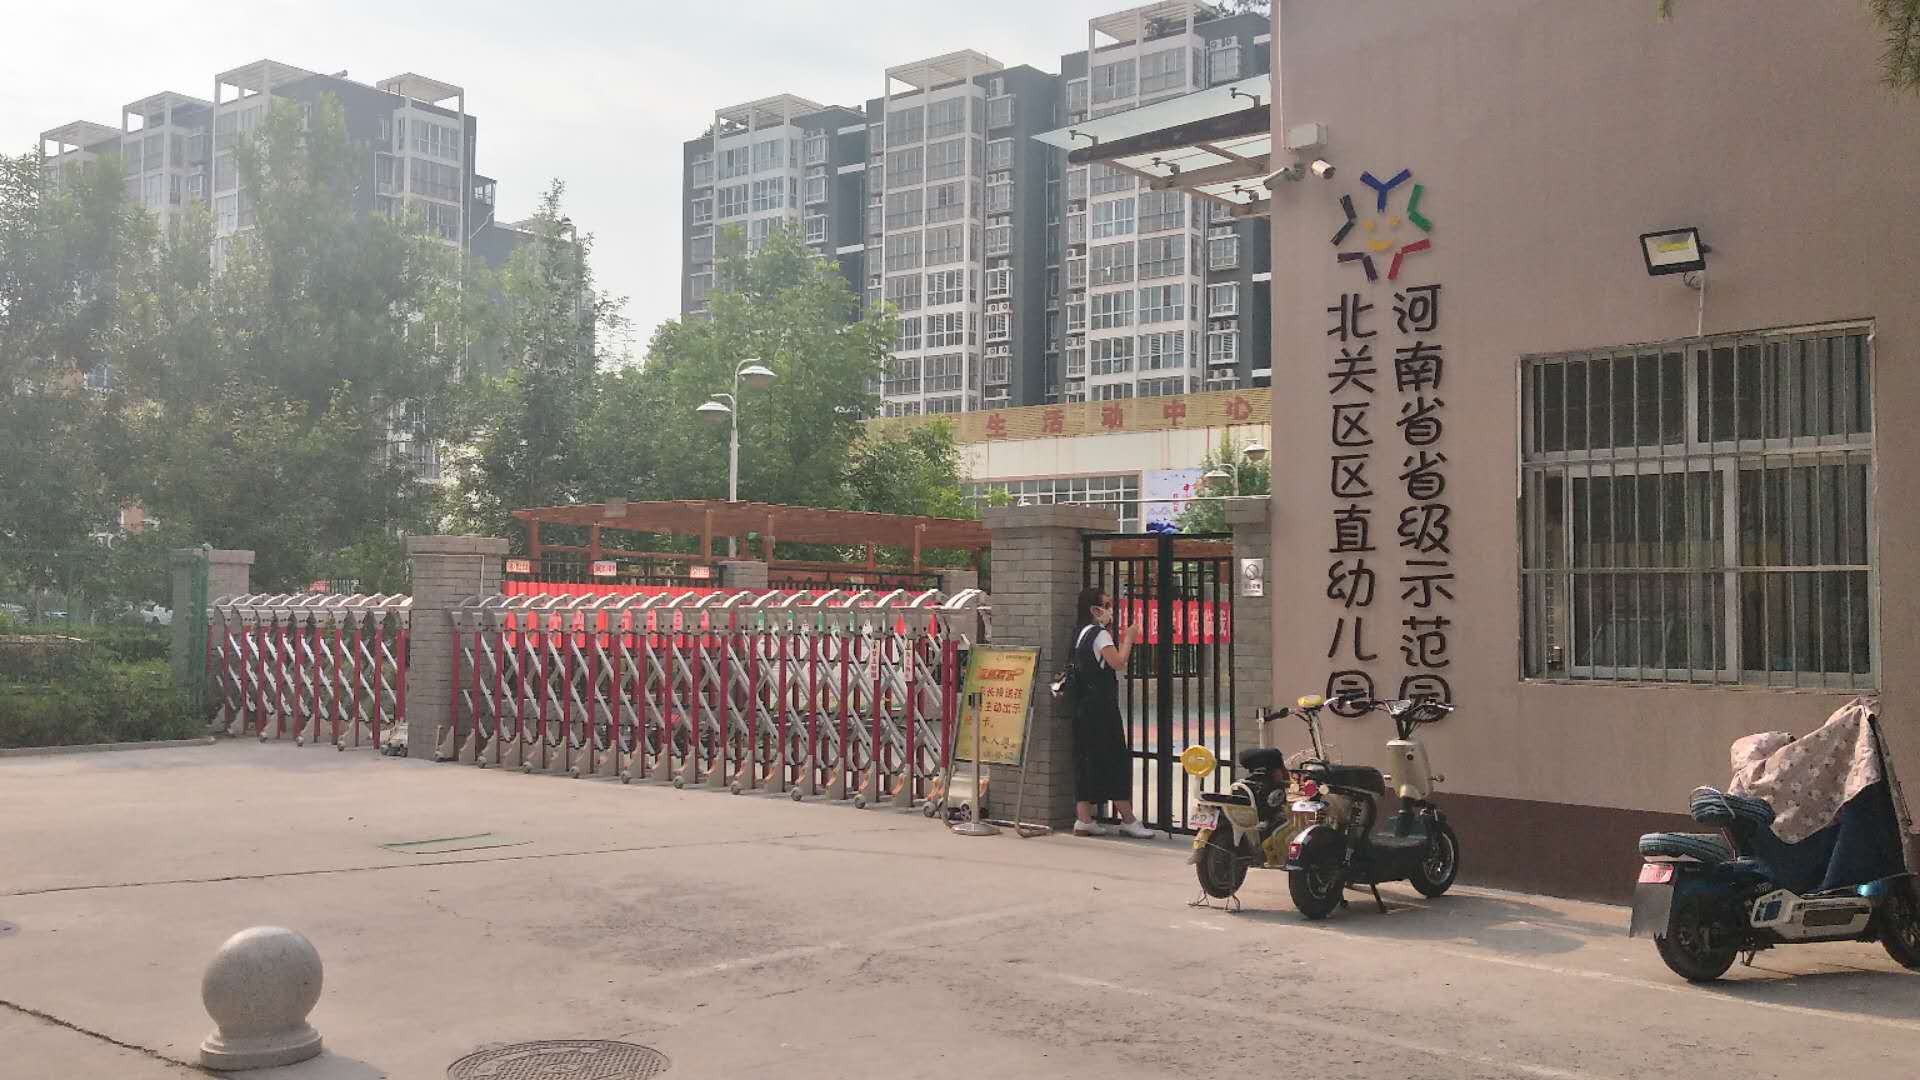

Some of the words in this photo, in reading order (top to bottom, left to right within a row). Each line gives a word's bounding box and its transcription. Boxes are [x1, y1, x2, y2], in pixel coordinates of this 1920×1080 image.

[978, 701, 1021, 715] 主动出示
[1326, 293, 1378, 718] 北关区区直幼儿园
[1392, 284, 1455, 723] 河南省省级示范园
